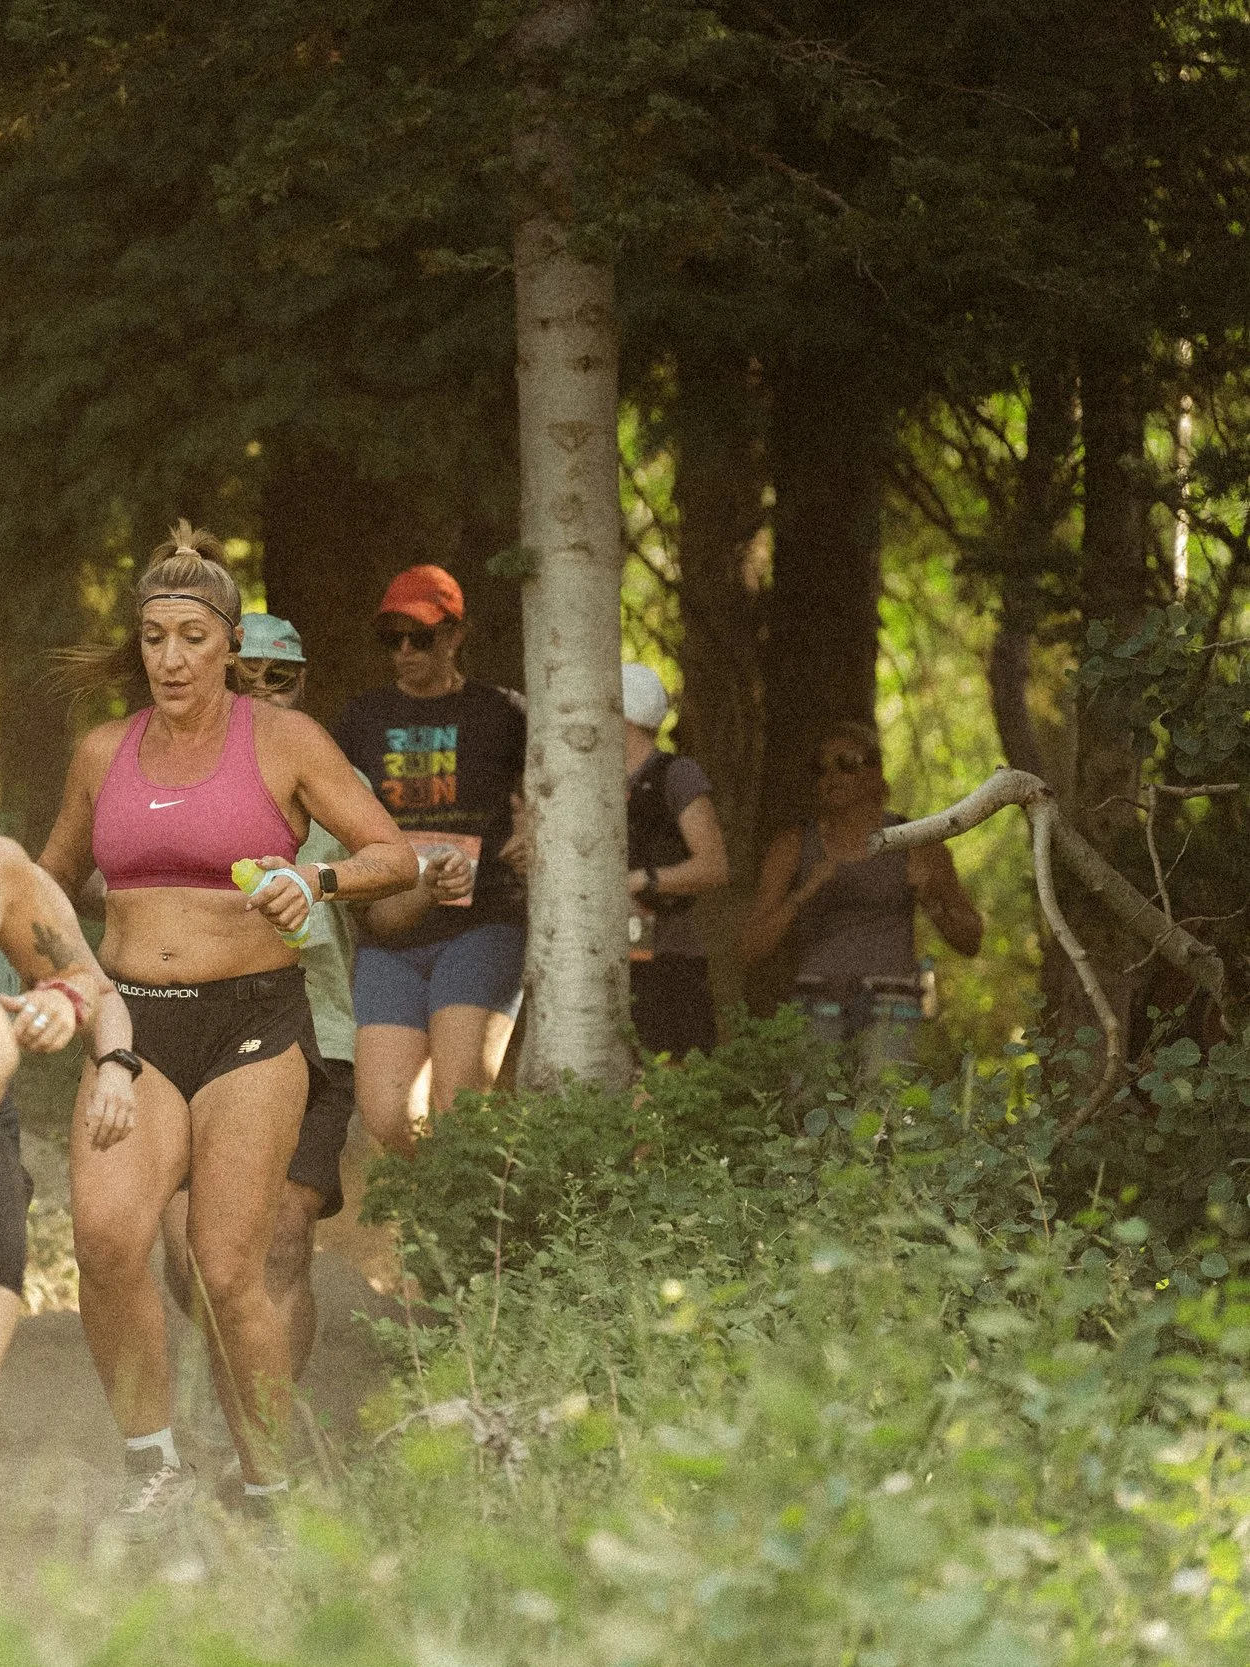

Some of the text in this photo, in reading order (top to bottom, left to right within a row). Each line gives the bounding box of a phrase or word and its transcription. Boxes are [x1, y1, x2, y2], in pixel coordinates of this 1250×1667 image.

[385, 725, 458, 752] RUN
[382, 751, 457, 777] RUN
[381, 775, 457, 808] RUN
[117, 981, 199, 998] VELOCHAMPION
